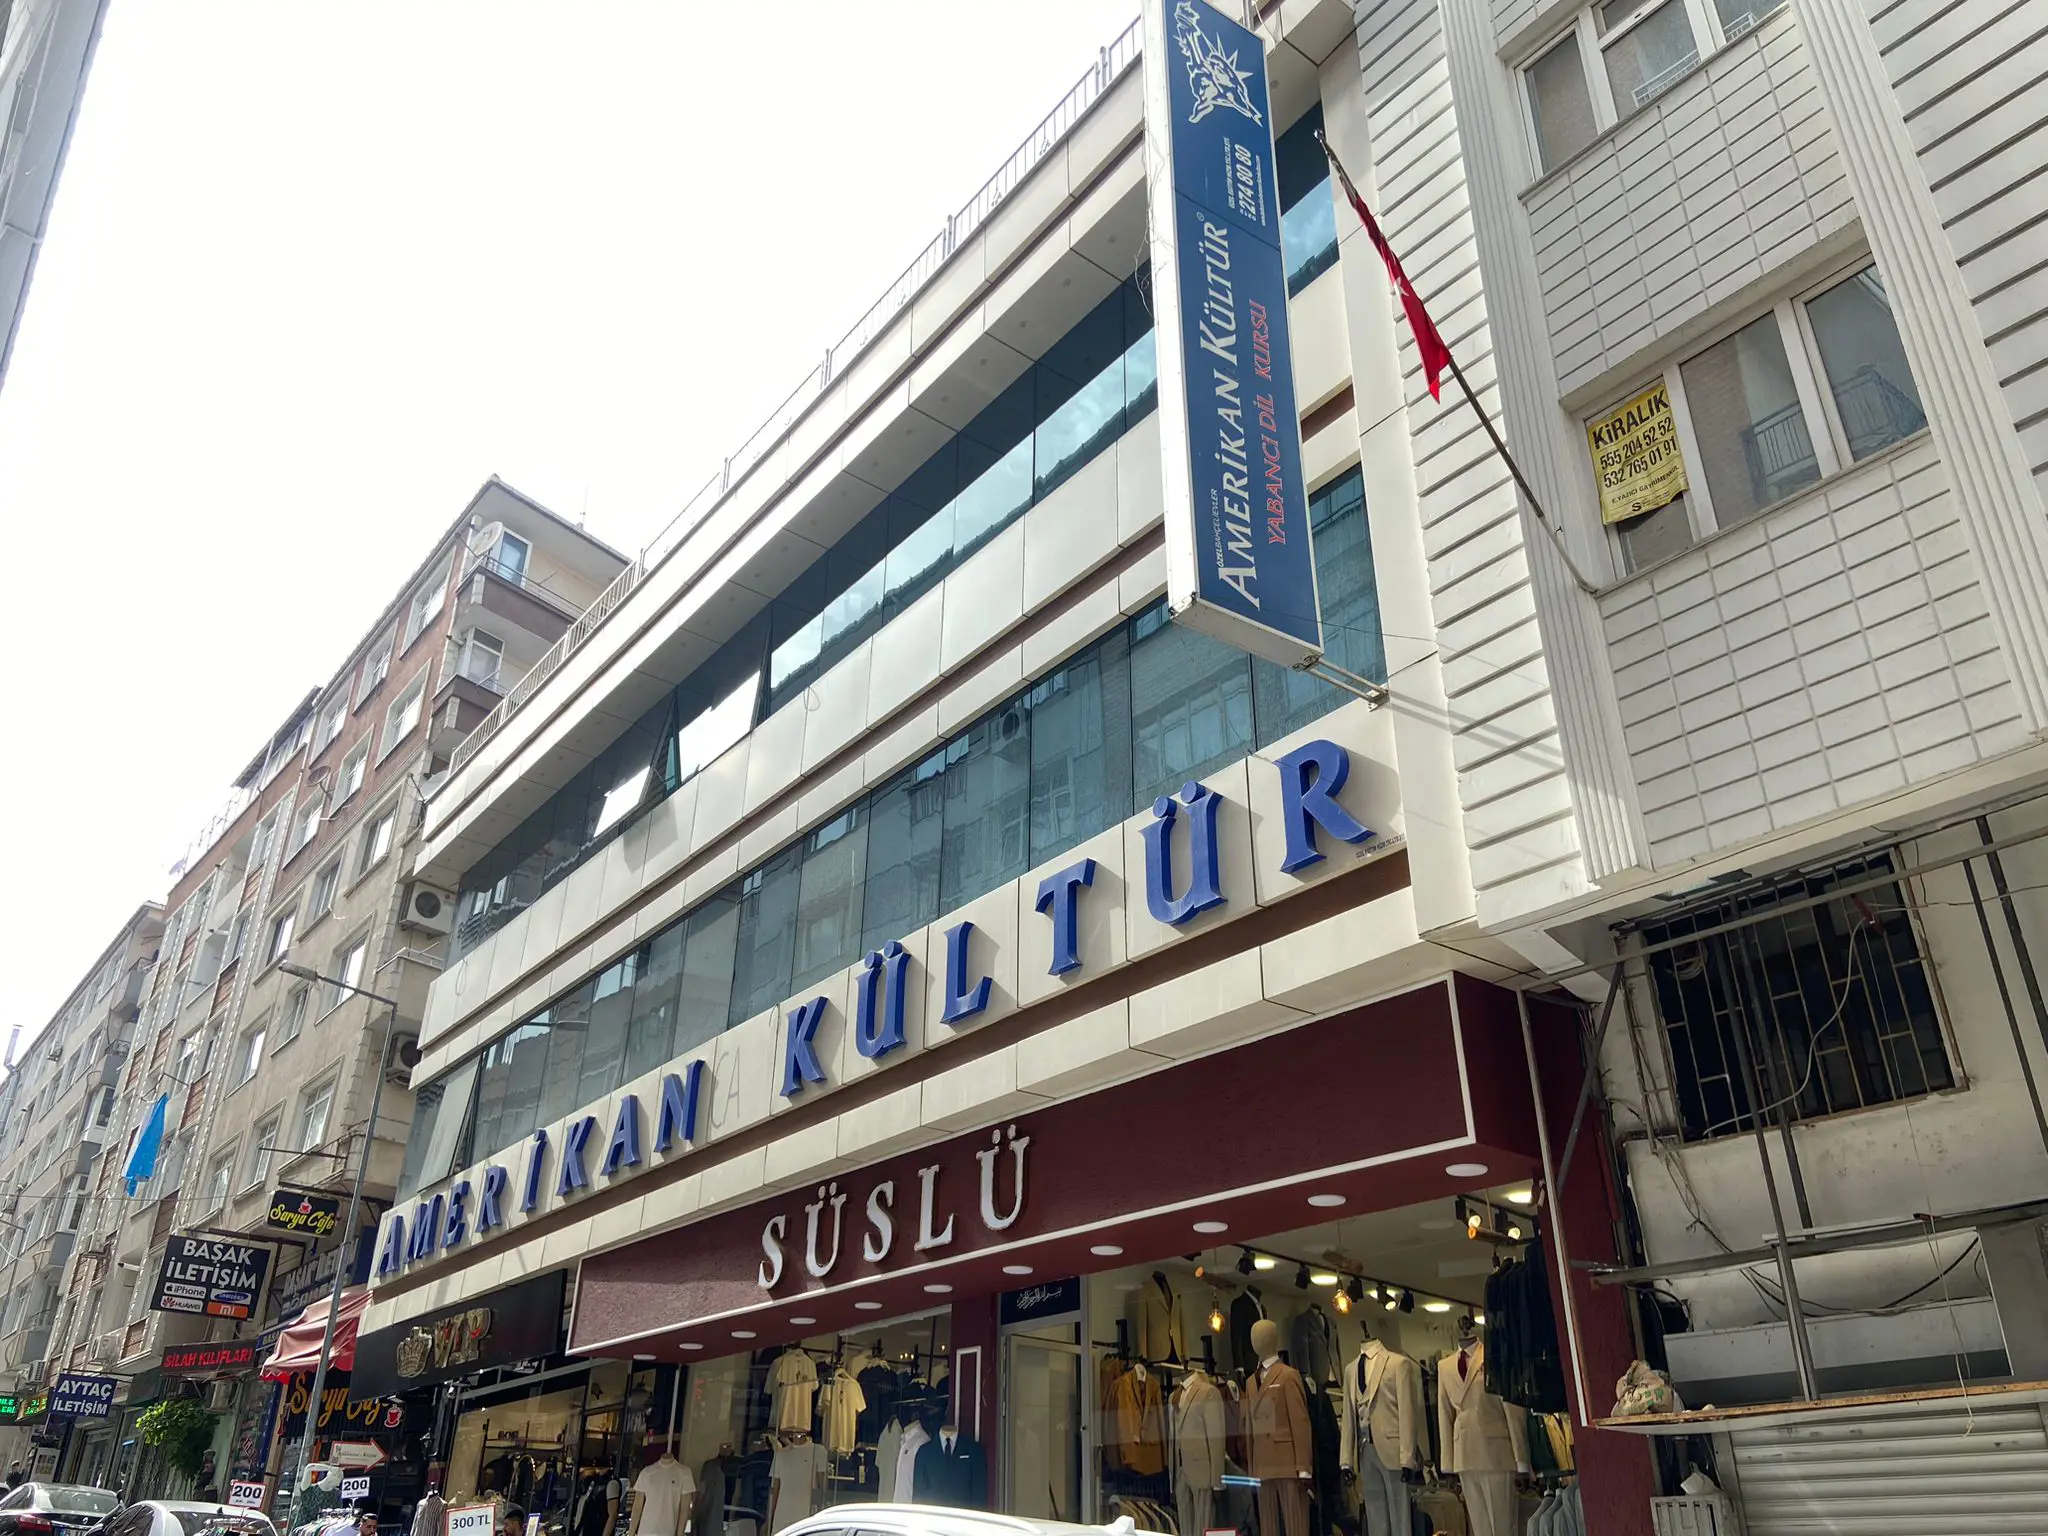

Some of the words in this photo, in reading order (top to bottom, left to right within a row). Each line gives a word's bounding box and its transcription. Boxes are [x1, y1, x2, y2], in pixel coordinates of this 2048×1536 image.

[1234, 144, 1251, 167] 80
[1235, 164, 1253, 186] 80
[1237, 183, 1257, 216] 274
[1199, 221, 1238, 367] KÜLTÜR
[1249, 298, 1272, 382] KURSU
[1252, 393, 1277, 433] DİL
[1600, 452, 1622, 470] 555
[1622, 436, 1643, 460] 204
[1643, 427, 1659, 447] 52
[1657, 416, 1674, 436] 52
[1603, 468, 1626, 489] 532
[1626, 455, 1649, 478] 765
[1648, 447, 1664, 466] 01
[1663, 436, 1677, 456] 91
[1213, 368, 1261, 611] AMERİKAN
[1262, 434, 1286, 545] YABANCI
[375, 1059, 706, 1279] AMERİKAN
[779, 739, 1377, 1099] KÜLTÜR
[270, 1203, 308, 1231] Sarya
[307, 1211, 335, 1235] Cafe
[757, 1124, 1031, 1290] SÜSLÜ
[182, 1239, 255, 1265] BAŞAK
[165, 1256, 257, 1290] İLETİŞİM
[174, 1285, 205, 1297] iPhone
[52, 1397, 108, 1416] İLETİŞİM
[58, 1380, 113, 1400] AYTAÇ
[232, 1485, 263, 1499] 200
[343, 1479, 368, 1491] 200
[451, 1516, 474, 1530] 300
[476, 1514, 491, 1526] TL
